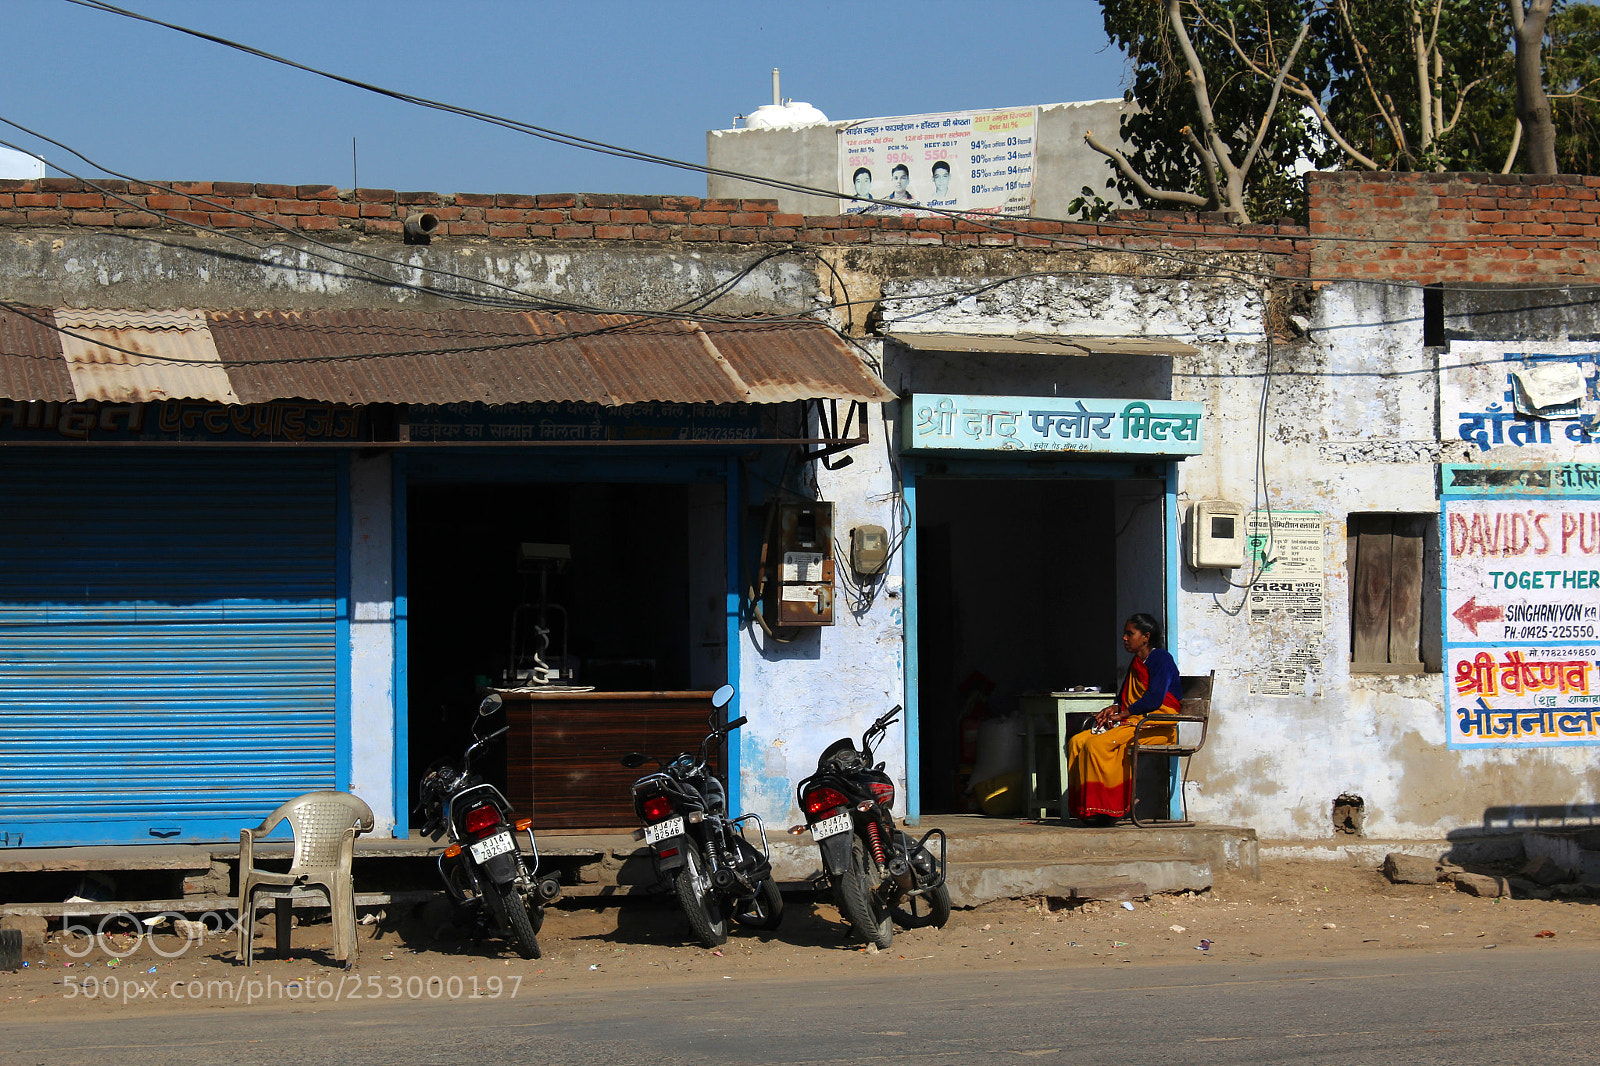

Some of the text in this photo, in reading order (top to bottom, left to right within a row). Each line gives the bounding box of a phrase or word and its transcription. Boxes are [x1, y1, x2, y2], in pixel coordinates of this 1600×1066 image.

[464, 423, 485, 438] का
[488, 423, 535, 439] सामान
[538, 419, 587, 439] मिलता
[917, 398, 958, 438] श्री
[1029, 400, 1116, 440] फ्लोर
[1120, 401, 1202, 441] मिल्स
[1450, 509, 1600, 557] DAVID'S PU
[1252, 582, 1294, 592] लक्ष्य
[1488, 569, 1600, 590] TOGETHER
[1505, 603, 1584, 623] SINGHANIYON
[1455, 650, 1591, 696] श्री वैष्णव
[822, 815, 842, 829] RJ47
[482, 834, 504, 850] RJ14
